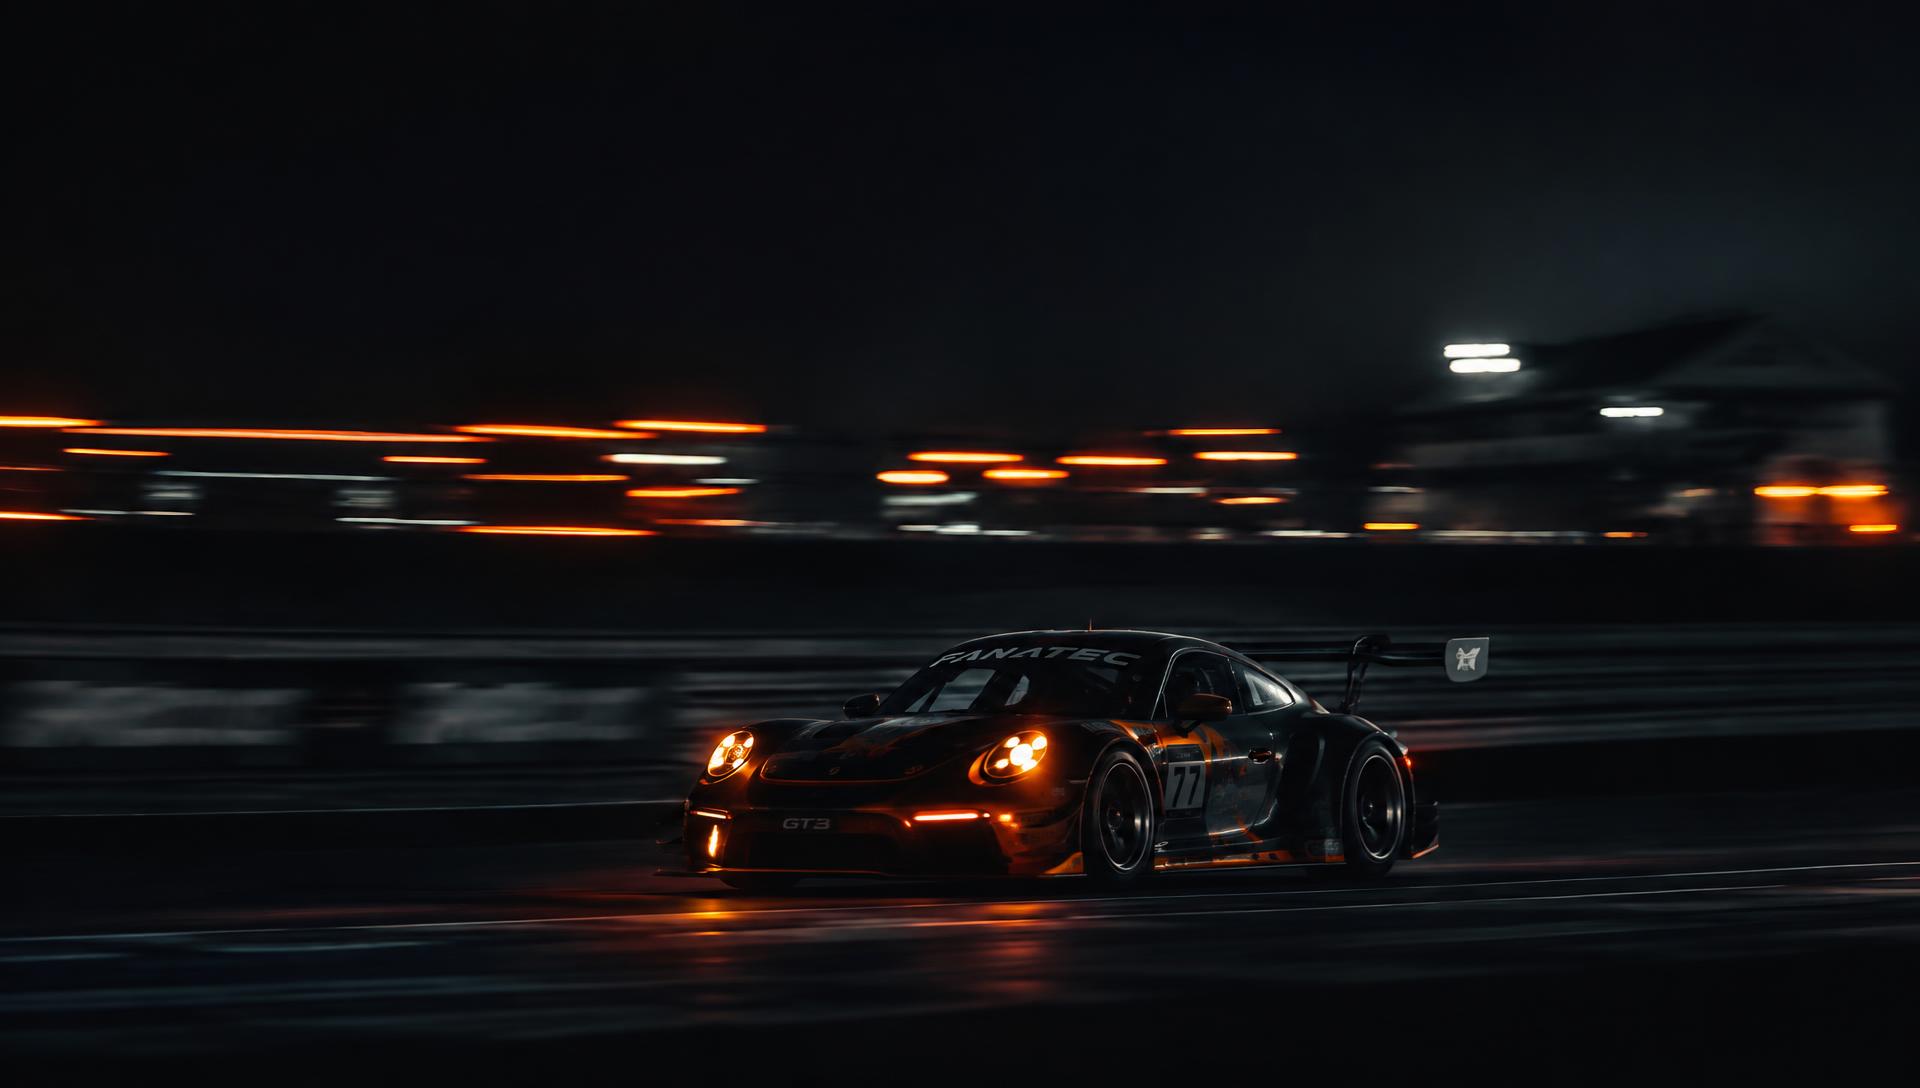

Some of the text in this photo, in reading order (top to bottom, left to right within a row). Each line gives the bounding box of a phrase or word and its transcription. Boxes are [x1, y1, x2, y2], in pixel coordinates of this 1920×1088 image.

[929, 647, 1142, 668] FANATEC
[1172, 766, 1201, 807] 77
[782, 817, 831, 830] GT3
